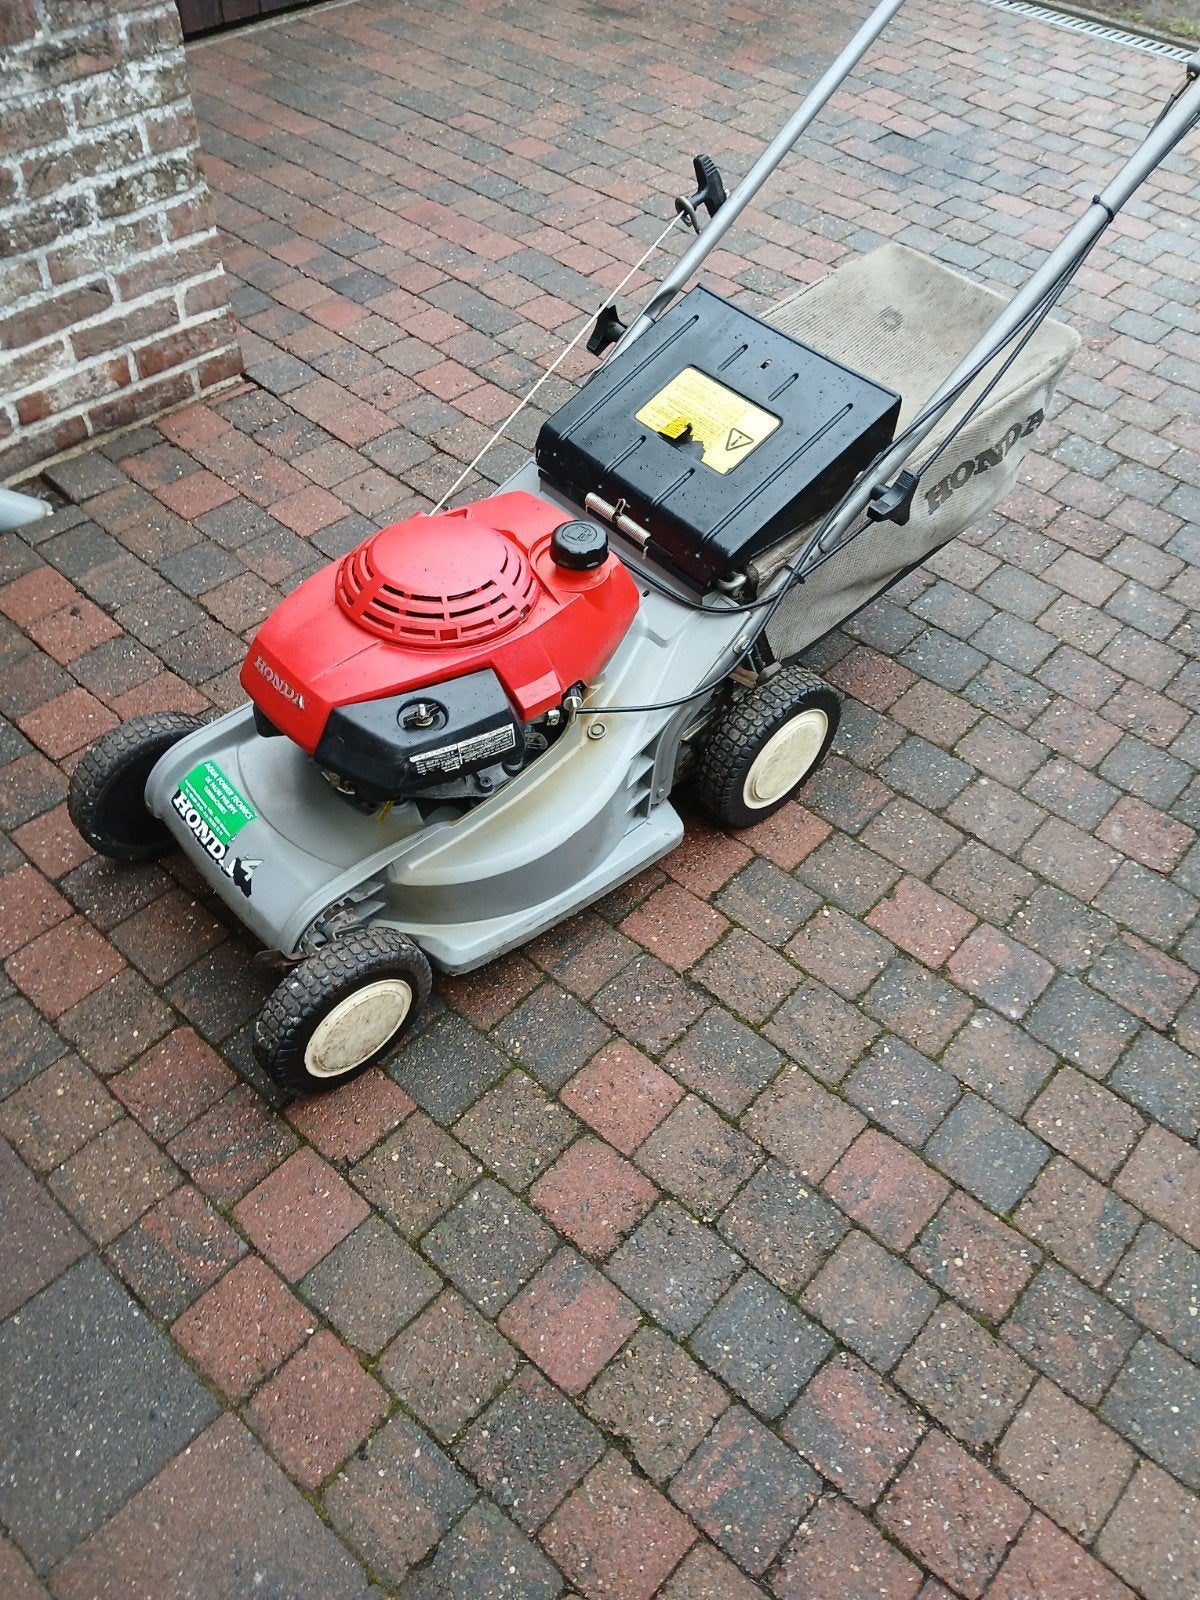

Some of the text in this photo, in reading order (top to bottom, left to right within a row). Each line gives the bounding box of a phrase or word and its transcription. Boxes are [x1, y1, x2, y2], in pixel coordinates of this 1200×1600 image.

[925, 408, 1045, 515] HONDA
[254, 656, 305, 709] HONDA
[217, 776, 235, 797] POWER
